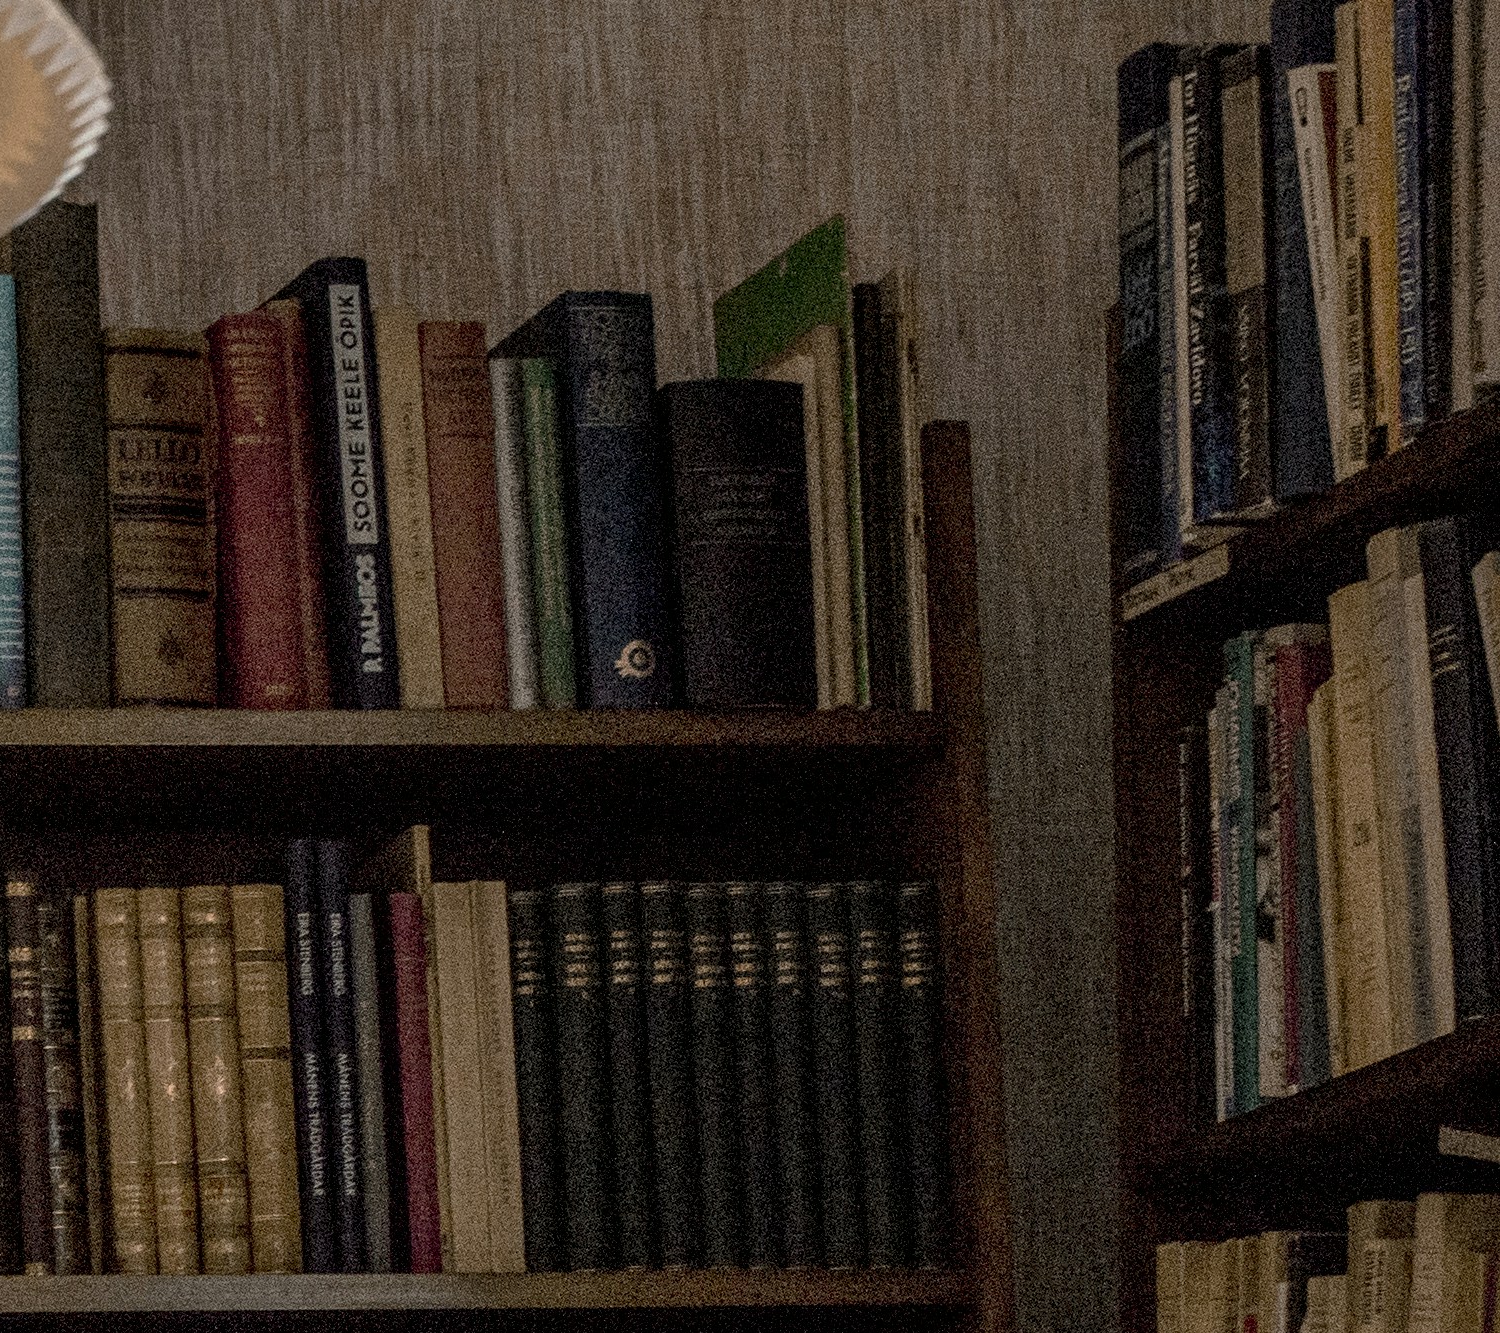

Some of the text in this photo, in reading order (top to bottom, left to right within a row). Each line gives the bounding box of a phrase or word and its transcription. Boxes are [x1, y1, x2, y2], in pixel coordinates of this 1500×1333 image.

[336, 293, 371, 532] SOOME KEELE ÕPIK
[305, 1052, 321, 1108] MÅNENS
[338, 1053, 353, 1108] MÅNENS
[308, 1112, 325, 1197] TRÄDGÅRDAR
[341, 1112, 357, 1197] TRÄDGÅRDAR
